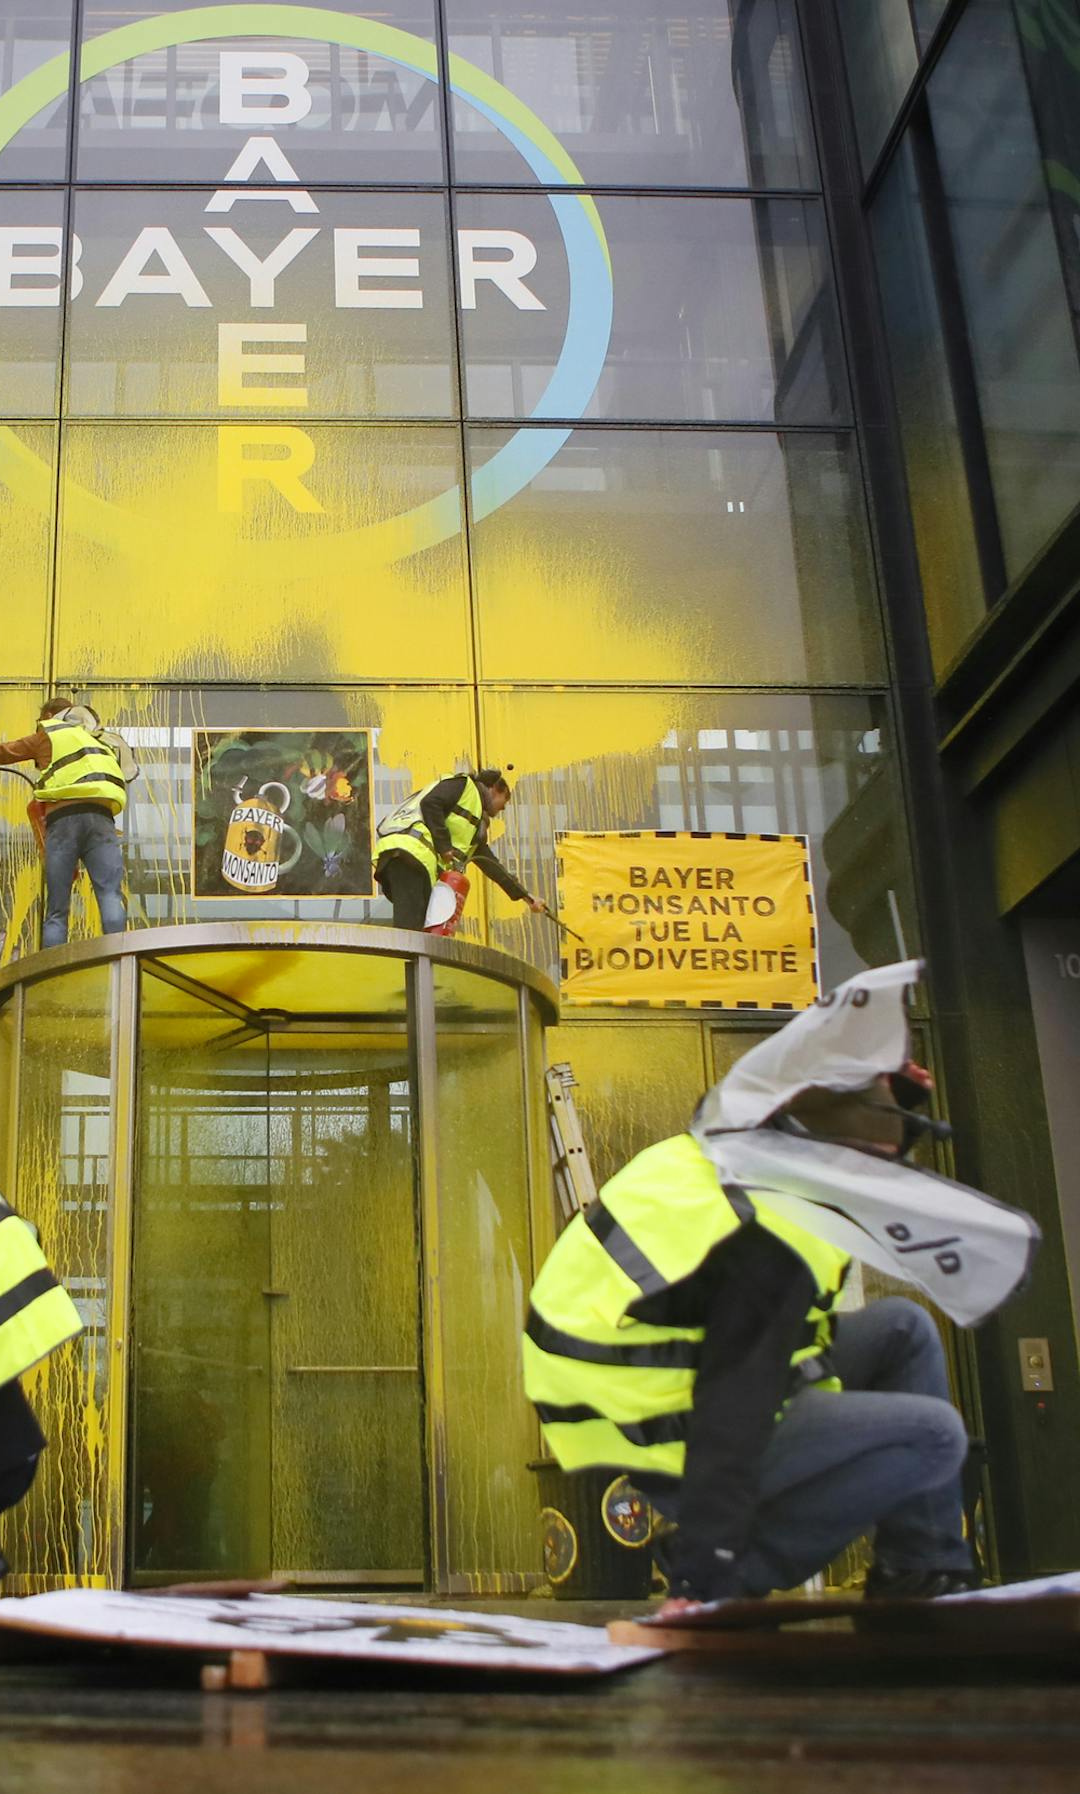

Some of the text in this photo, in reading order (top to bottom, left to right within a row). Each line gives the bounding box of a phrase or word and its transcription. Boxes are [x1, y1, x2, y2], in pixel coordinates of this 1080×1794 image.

[204, 51, 325, 514] BAYER
[232, 808, 282, 832] BAYER
[223, 852, 277, 884] MONSANTO
[629, 866, 735, 890] BAYER
[592, 893, 776, 917] MONSANTO
[629, 920, 743, 943] TUE LA
[575, 944, 798, 973] BIODIVERSITÉ
